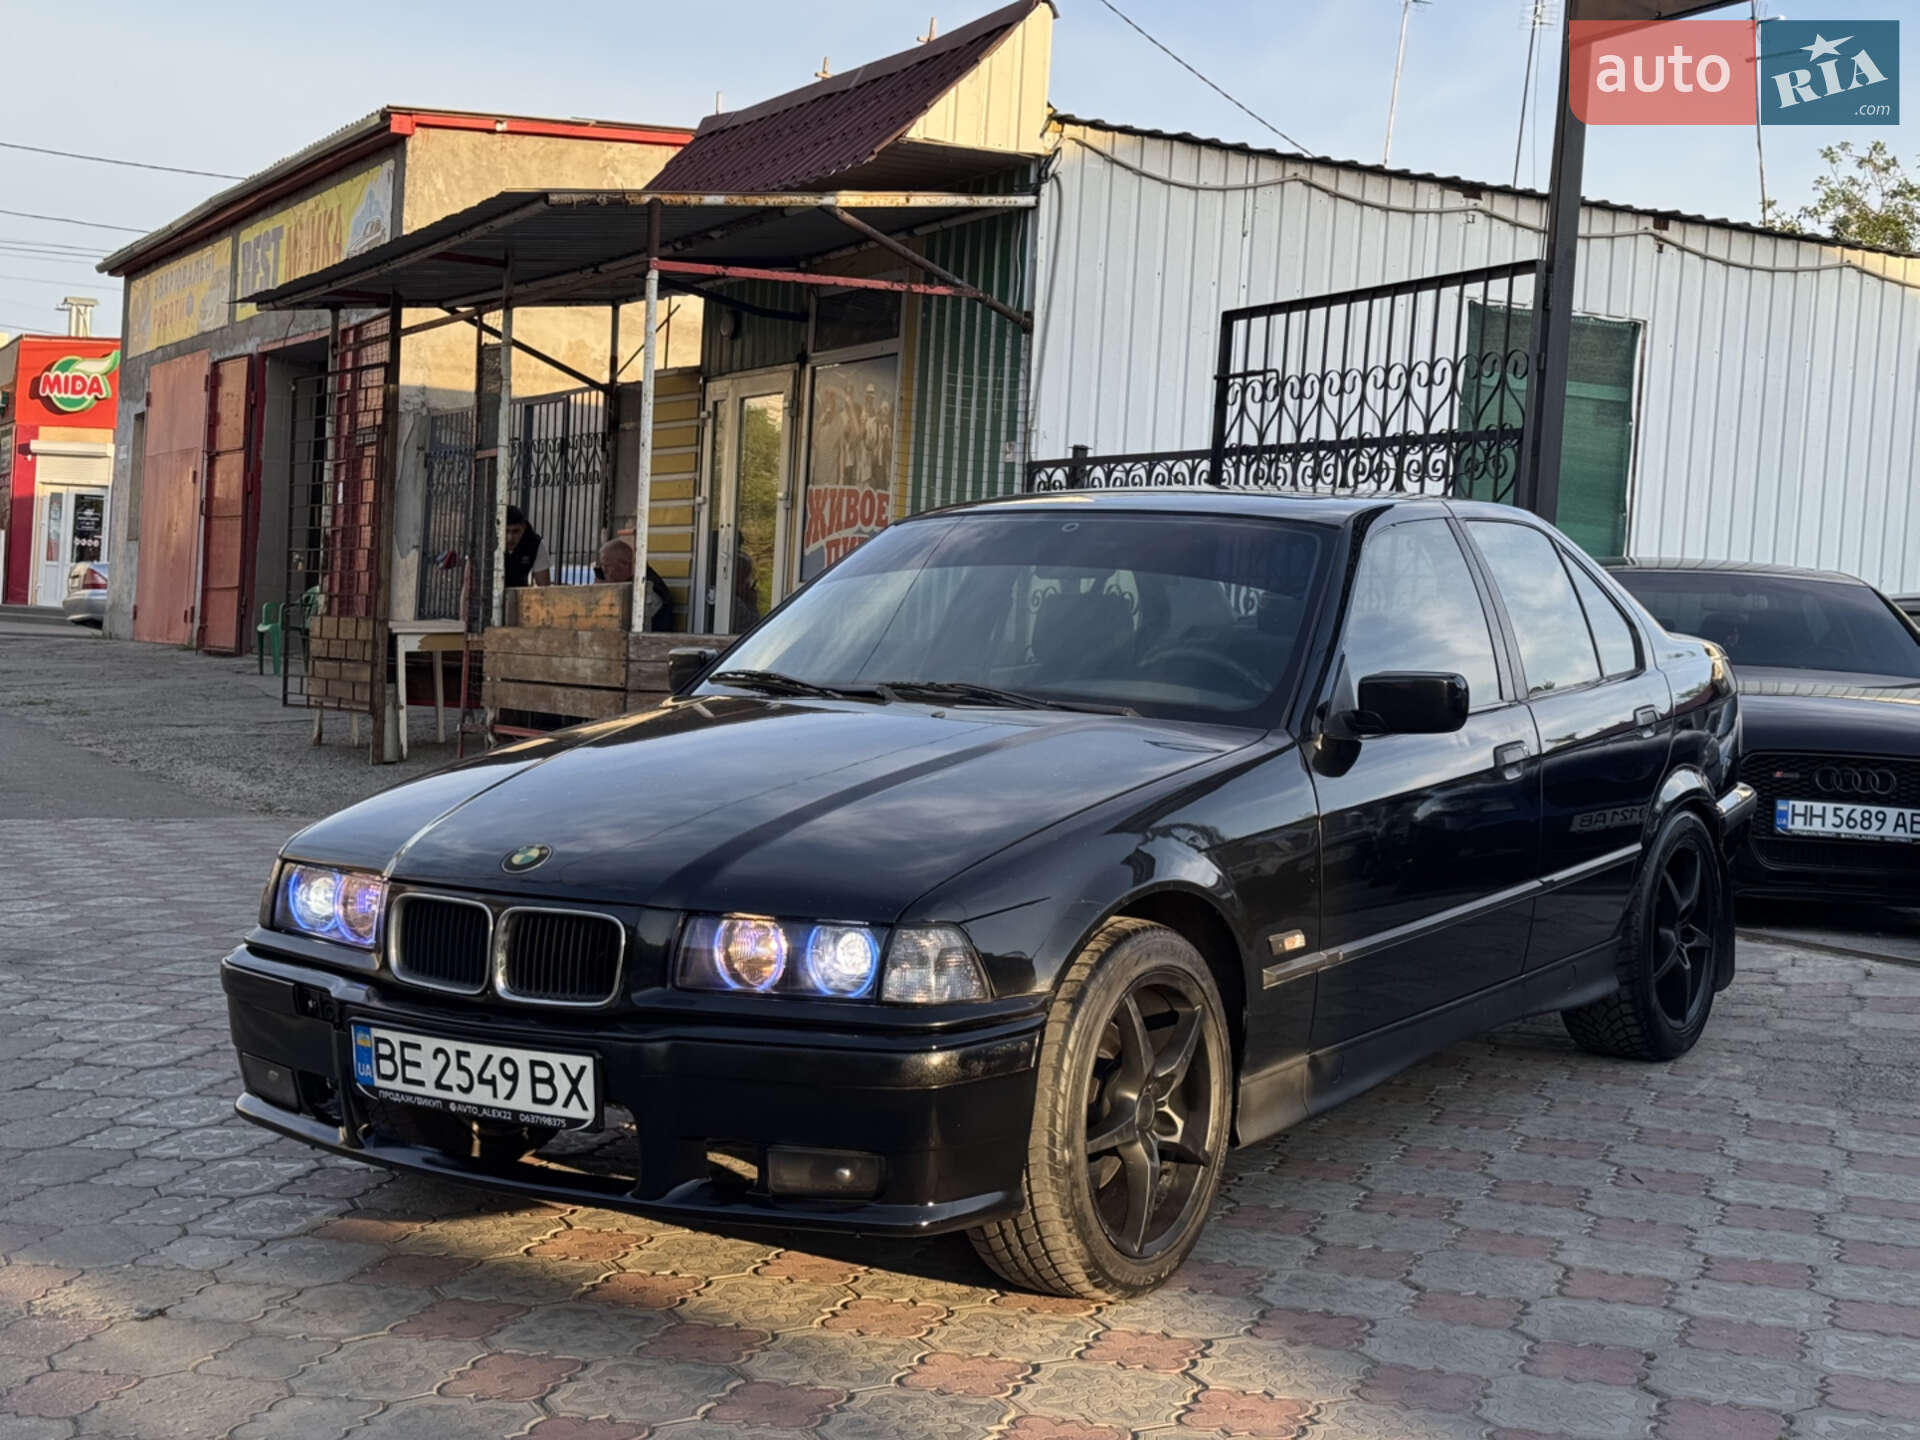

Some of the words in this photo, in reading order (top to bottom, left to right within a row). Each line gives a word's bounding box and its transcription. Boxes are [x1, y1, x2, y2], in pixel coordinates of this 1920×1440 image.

[241, 225, 284, 299] BEST
[40, 373, 104, 397] MIDA
[803, 487, 890, 549] ЖИВОЕ
[1791, 804, 1826, 828] HH
[1832, 807, 1887, 832] 5689
[358, 1063, 373, 1077] UA
[374, 1036, 426, 1088] BE
[432, 1047, 519, 1101] 2549
[529, 1059, 589, 1112] BX
